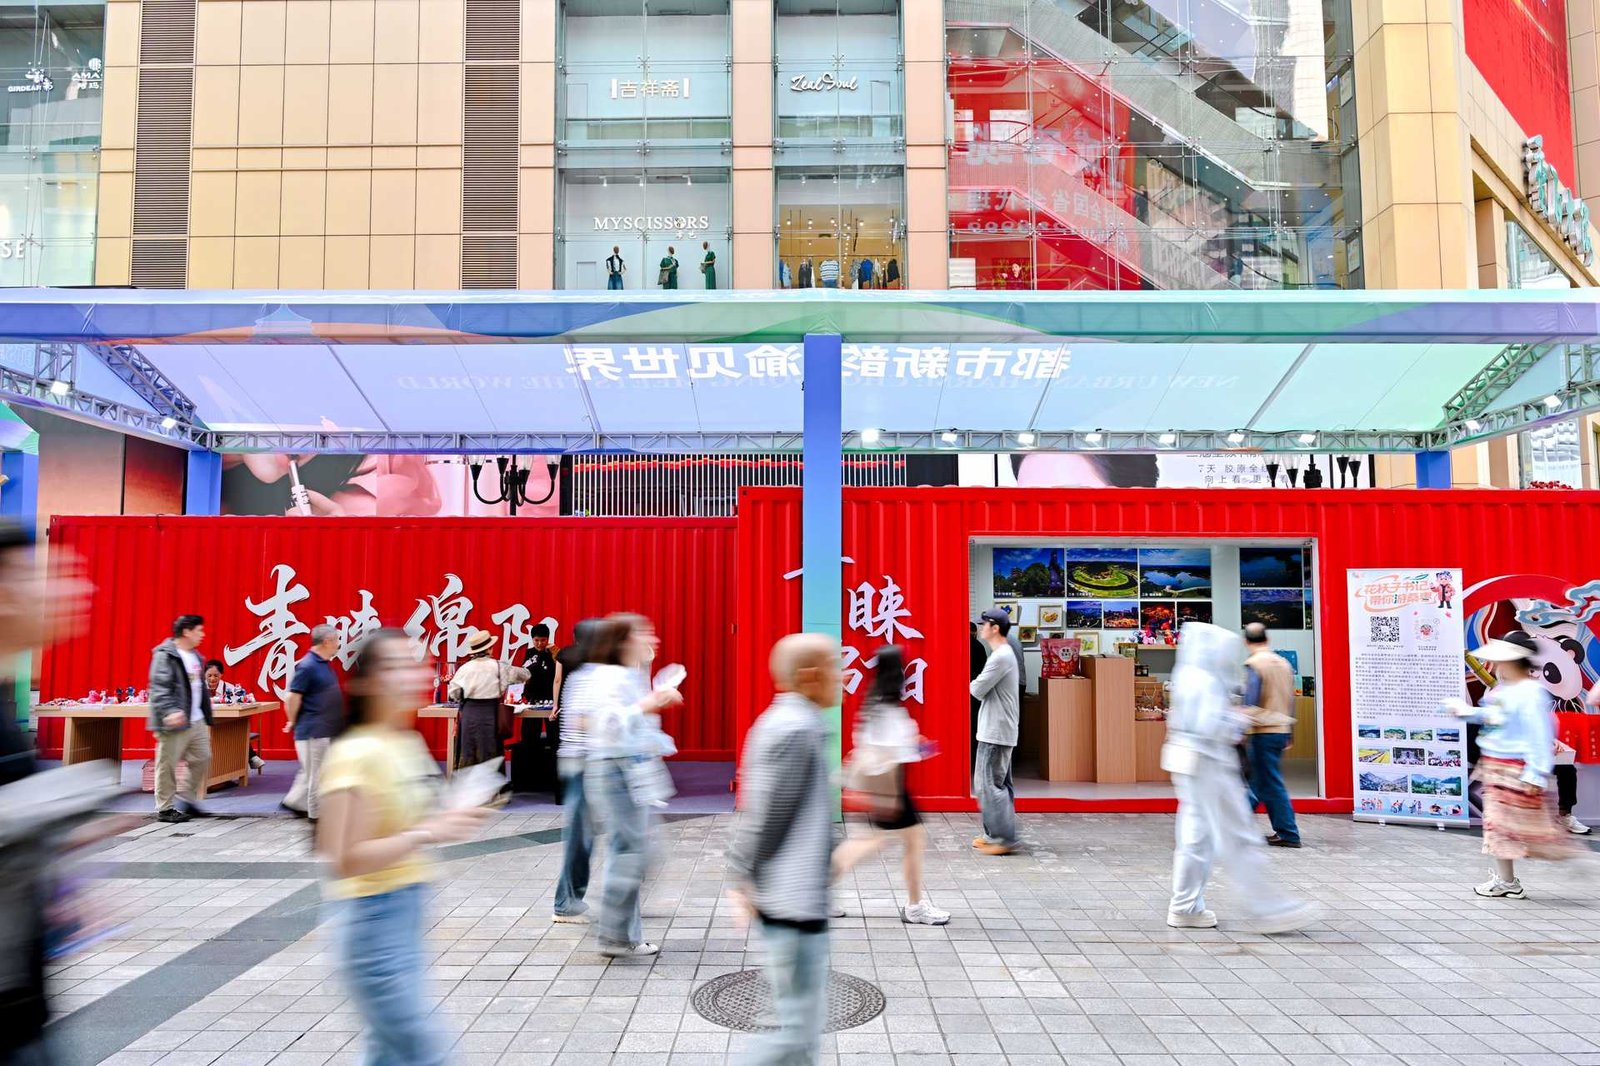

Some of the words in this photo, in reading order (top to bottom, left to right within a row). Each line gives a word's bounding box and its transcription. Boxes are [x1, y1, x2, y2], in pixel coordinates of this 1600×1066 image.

[619, 79, 680, 98] 吉祥斋
[593, 215, 710, 232] MYSCISSORS
